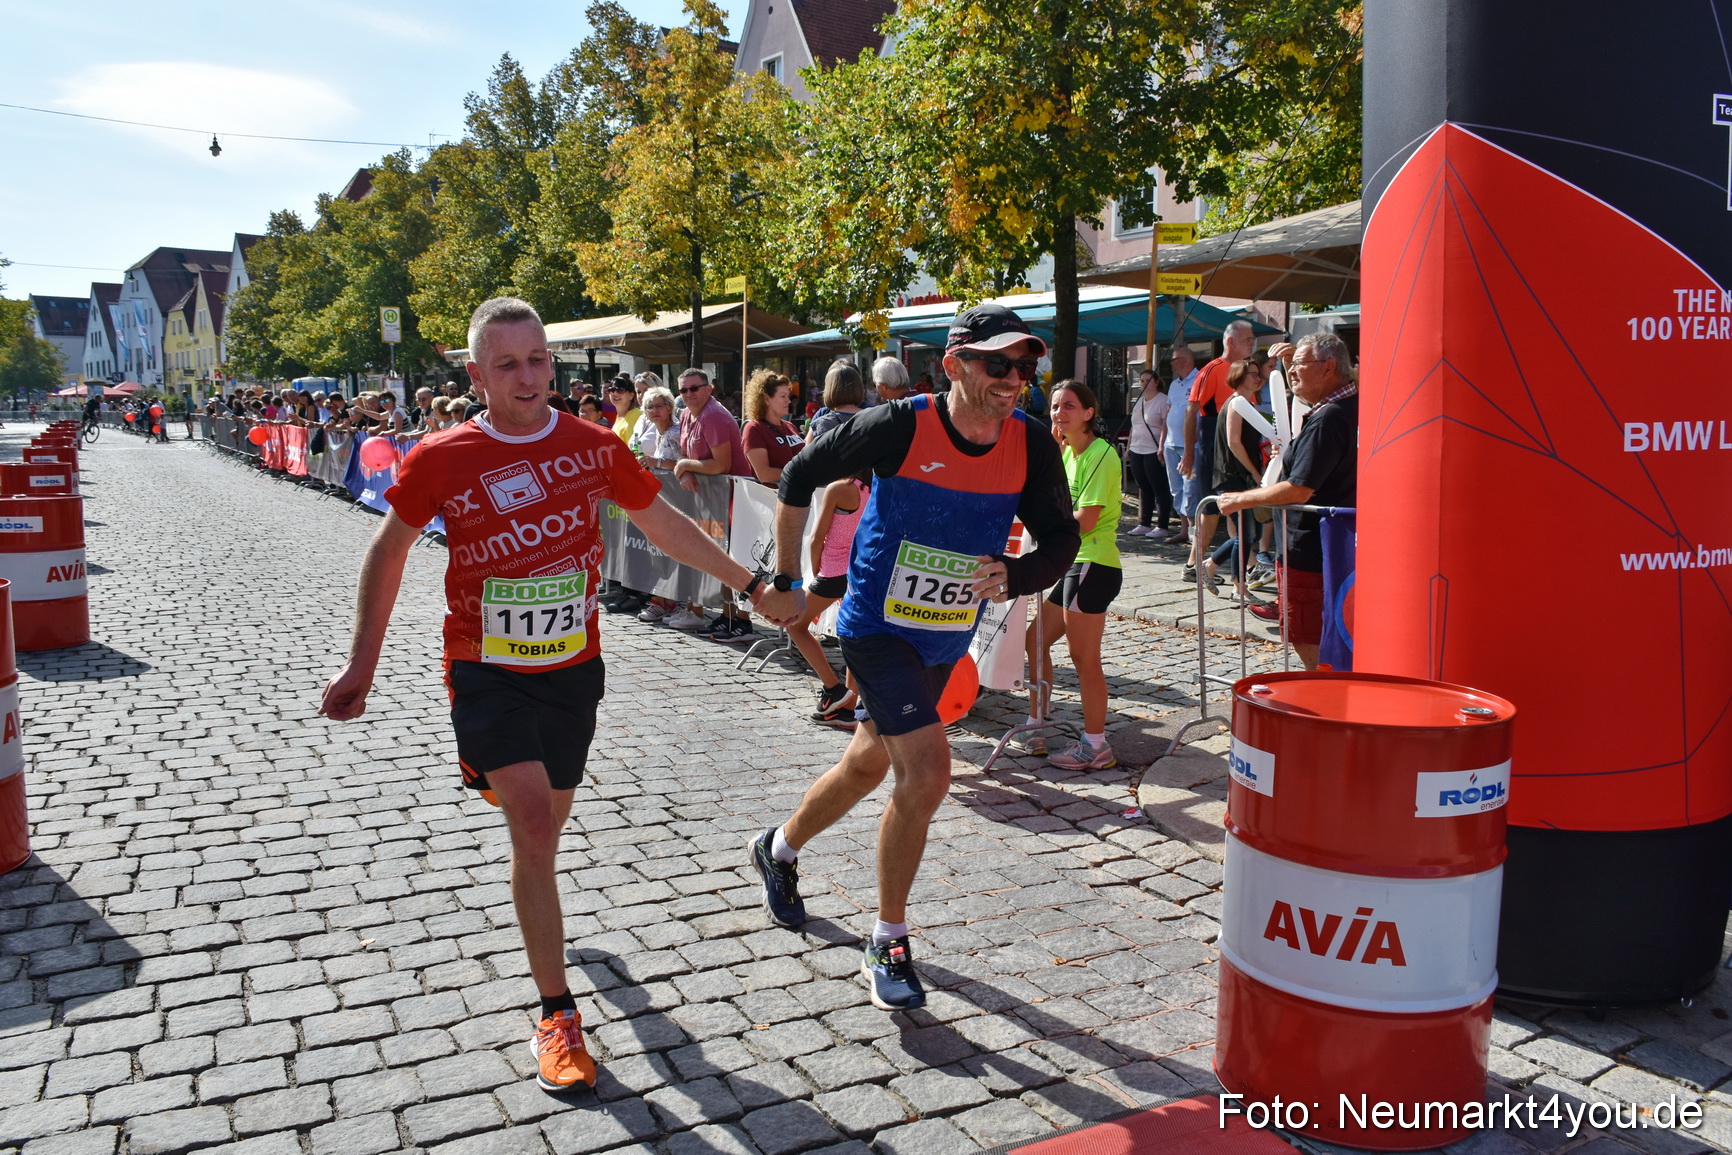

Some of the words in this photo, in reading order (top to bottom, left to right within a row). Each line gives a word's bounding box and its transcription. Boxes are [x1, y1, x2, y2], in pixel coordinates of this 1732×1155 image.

[1163, 235, 1182, 243] ausgabe
[1673, 289, 1716, 313] THE
[1627, 316, 1673, 341] 100
[1624, 420, 1714, 452] BMW
[485, 464, 529, 485] raumbox
[553, 475, 599, 496] schenken
[500, 551, 544, 573] wohnen
[552, 530, 587, 553] outdoor
[905, 546, 986, 575] BOCK
[1620, 544, 1732, 571] www.bm
[493, 577, 578, 601] BOCK
[905, 574, 974, 605] 1265
[497, 604, 574, 636] 1173
[893, 603, 968, 621] SCHORSCHI
[508, 641, 566, 656] TOBIAS
